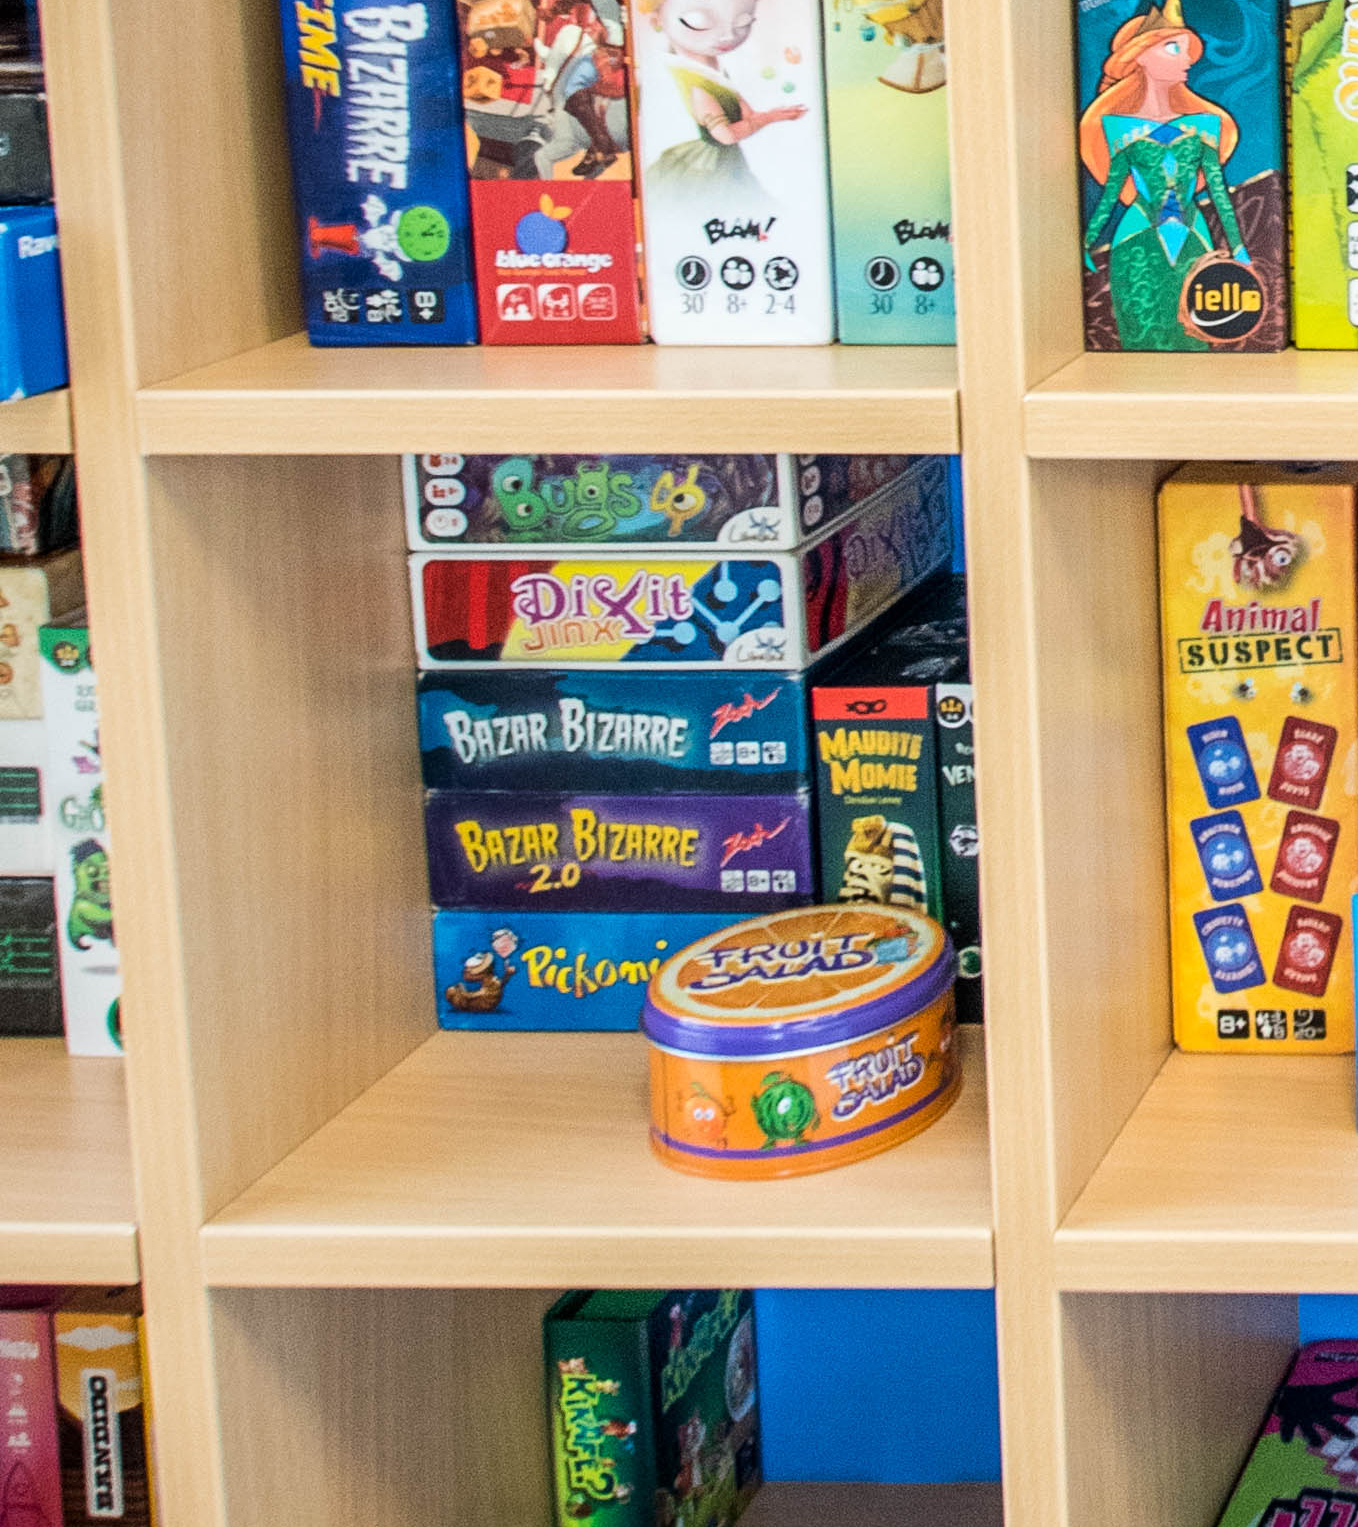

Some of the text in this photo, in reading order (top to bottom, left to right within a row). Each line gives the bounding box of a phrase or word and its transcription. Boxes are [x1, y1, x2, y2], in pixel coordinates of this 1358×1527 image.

[344, 1, 428, 191] BIZARRE
[765, 292, 797, 315] 2-4
[1199, 598, 1321, 634] Animal
[1185, 634, 1336, 668] SUSPECT
[443, 695, 689, 766] BAZAR BIZARRE
[829, 756, 918, 795] MOMIE
[455, 807, 700, 875] BAZAR BIZARRE
[527, 861, 582, 895] 2.0
[87, 1376, 116, 1513] BANDIDO
